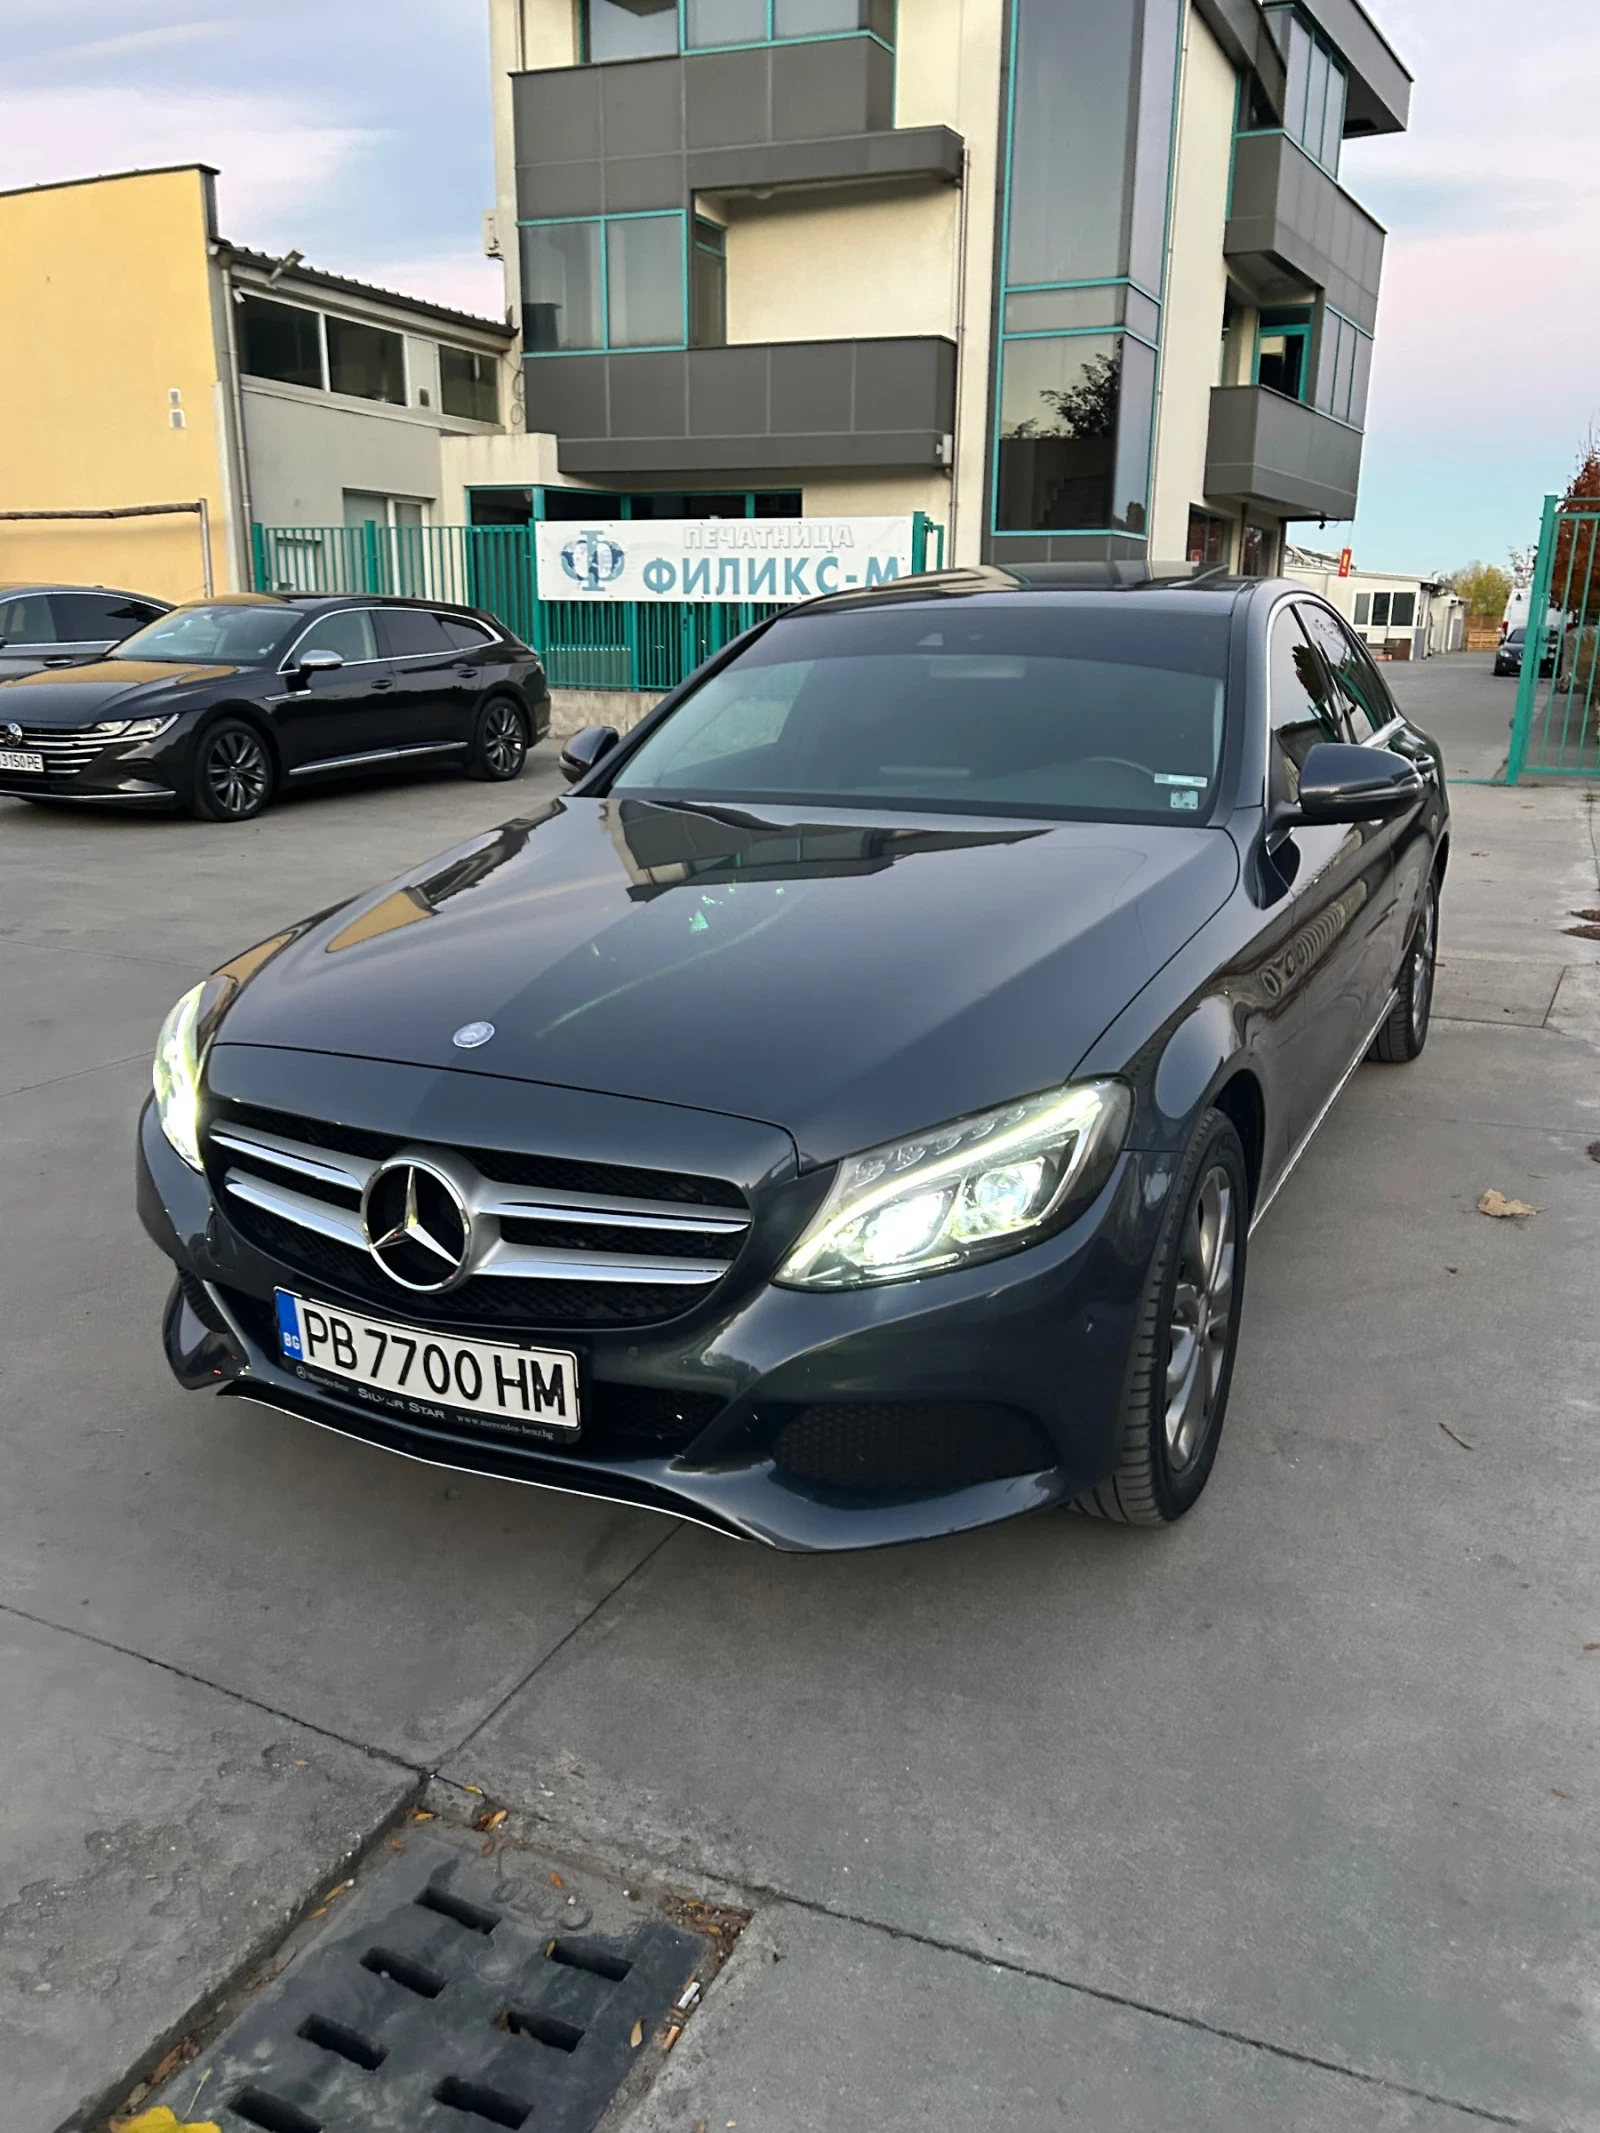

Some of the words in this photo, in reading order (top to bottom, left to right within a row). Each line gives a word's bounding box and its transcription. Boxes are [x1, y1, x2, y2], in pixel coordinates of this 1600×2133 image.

[684, 525, 855, 553] ПЕЧАТНИЦА
[643, 556, 899, 596] ФИЛИКС-М
[283, 1332, 300, 1350] BG
[303, 1307, 358, 1371] PB
[364, 1328, 482, 1401] 7700
[494, 1354, 567, 1417] HM
[408, 1401, 446, 1420] STAR
